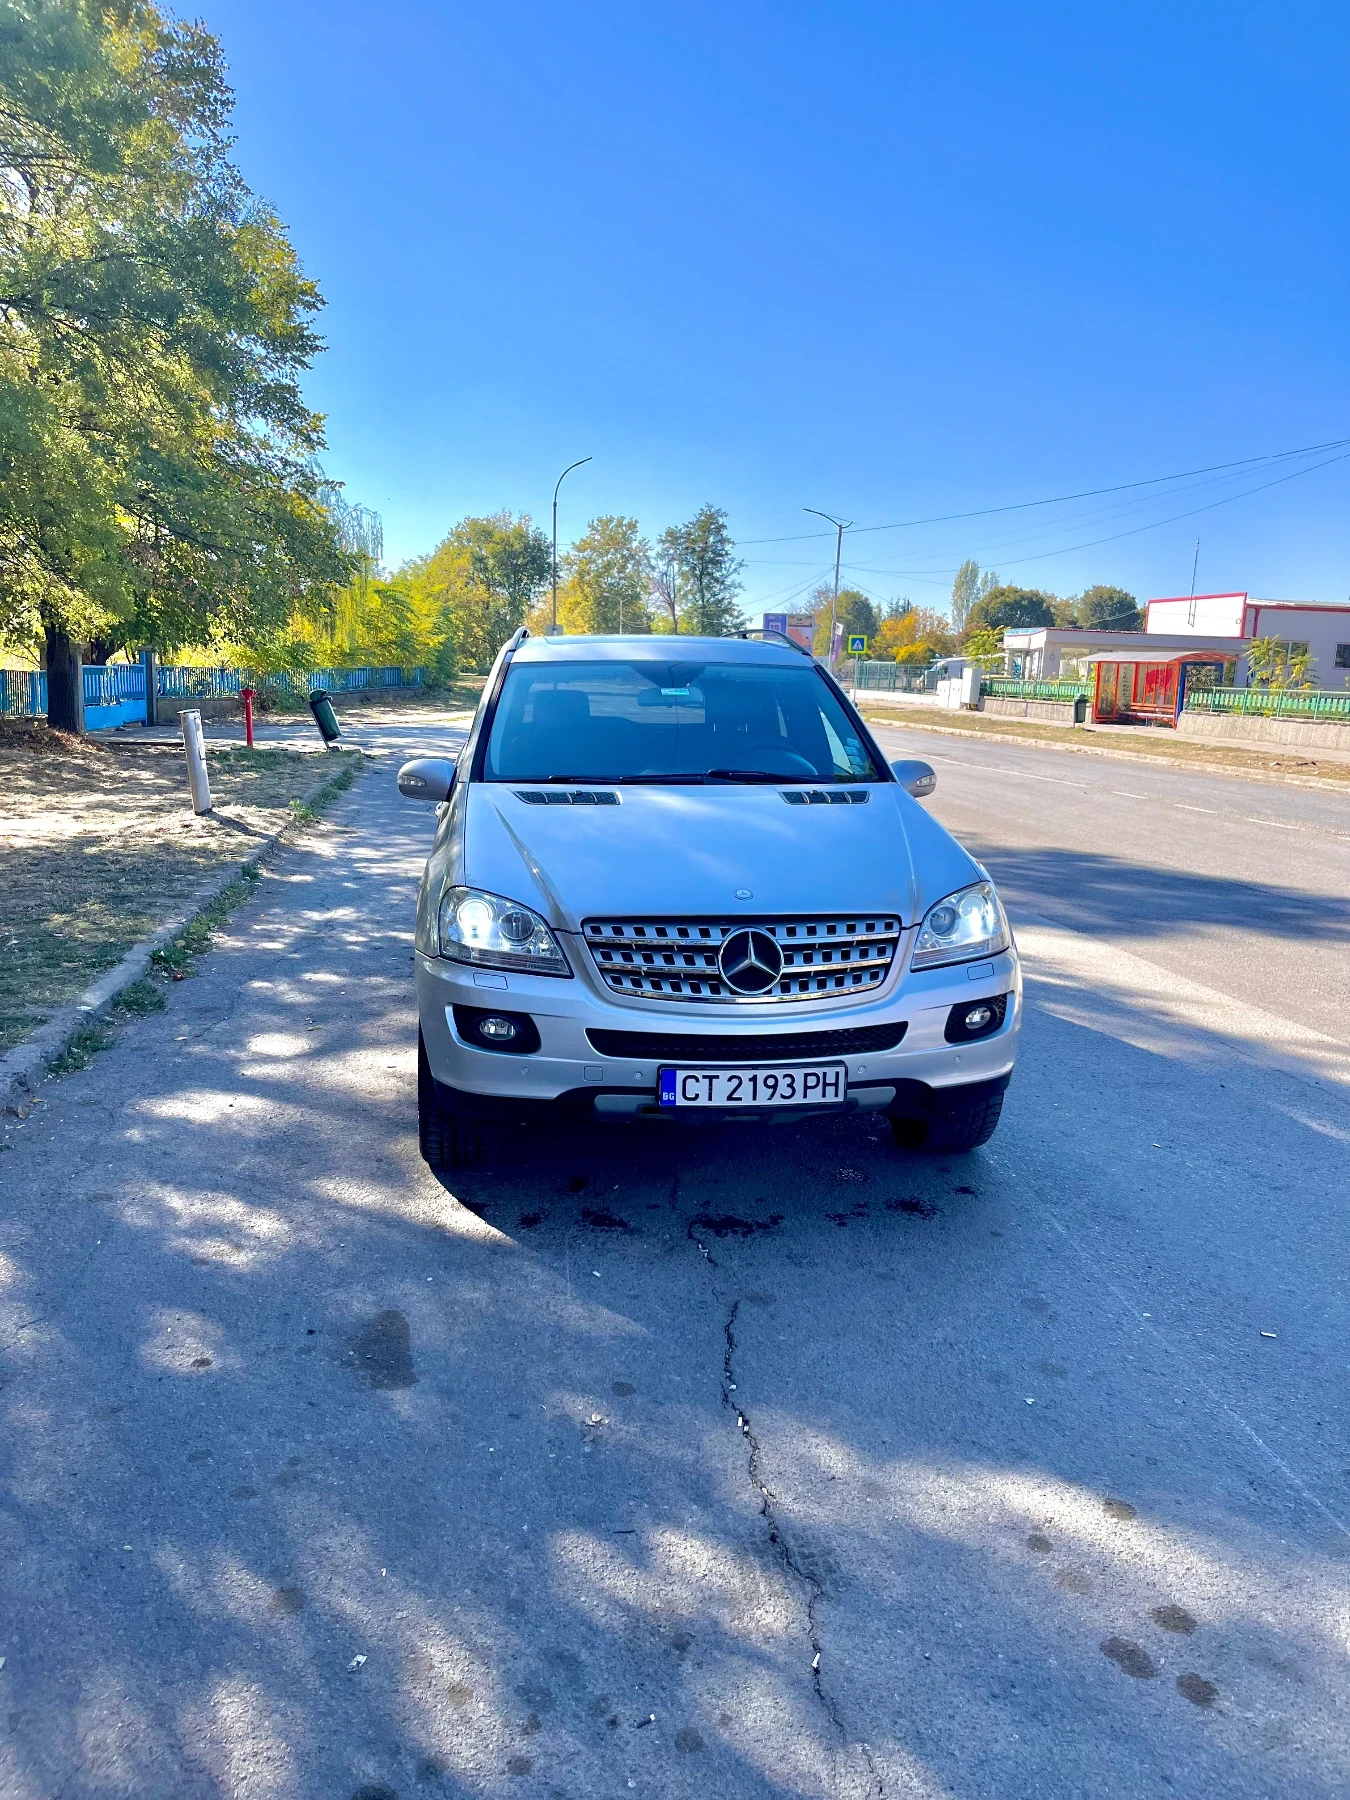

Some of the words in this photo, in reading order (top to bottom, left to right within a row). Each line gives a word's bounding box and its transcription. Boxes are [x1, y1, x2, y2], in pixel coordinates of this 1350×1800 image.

[682, 1074, 719, 1101] CT
[726, 1073, 796, 1101] 2193
[803, 1071, 839, 1099] PH
[662, 1092, 675, 1101] BG
